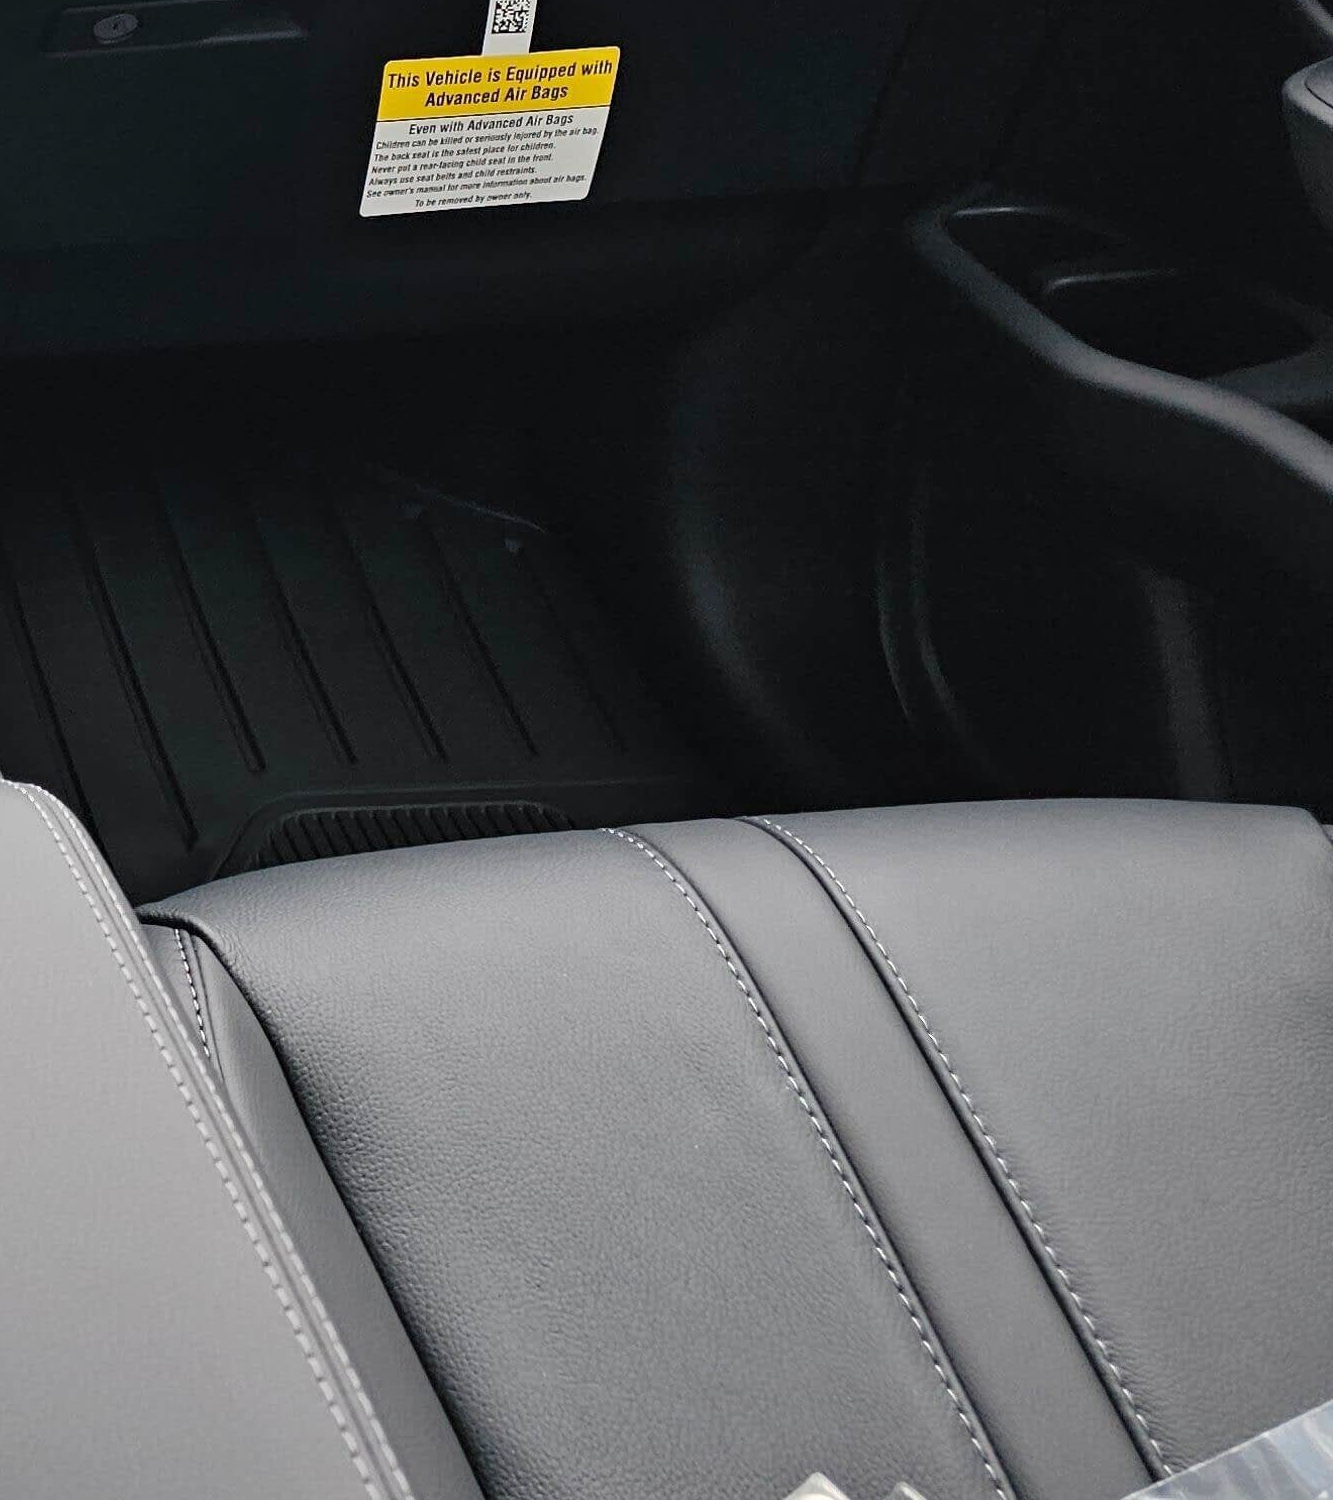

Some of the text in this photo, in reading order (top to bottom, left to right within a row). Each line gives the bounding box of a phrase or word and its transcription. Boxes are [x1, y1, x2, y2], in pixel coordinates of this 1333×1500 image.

[388, 60, 613, 89] This Vehicle is Equipped with
[425, 84, 568, 107] Advanced Air Bags
[409, 114, 574, 135] Even with Advanced Air Bags
[376, 141, 410, 150] Children
[428, 138, 438, 146] be
[440, 136, 462, 145] killed
[475, 133, 511, 143] seriously
[513, 130, 541, 141] injured
[543, 130, 553, 139] by
[555, 128, 567, 137] the
[569, 128, 580, 136] air
[374, 142, 556, 162] The back seat is the safest place for children.
[372, 166, 396, 174] Never
[398, 164, 411, 174] put
[420, 160, 464, 171] rear-facing
[466, 158, 486, 166] child
[488, 157, 506, 166] seat
[508, 156, 516, 164] in
[518, 155, 531, 163] the
[367, 190, 382, 198] See
[383, 187, 414, 196] owner's
[416, 184, 445, 193] manual
[447, 183, 458, 191] for
[483, 179, 527, 188] information
[530, 176, 551, 184] about
[553, 175, 564, 183] air
[369, 178, 397, 186] Always
[417, 174, 434, 182] seat
[436, 172, 455, 181] belts
[458, 170, 473, 178] and
[475, 168, 494, 177] child
[497, 167, 537, 176] restraints.
[415, 199, 424, 207] To
[426, 198, 436, 206] be
[438, 196, 473, 205] removed
[475, 194, 485, 203] by
